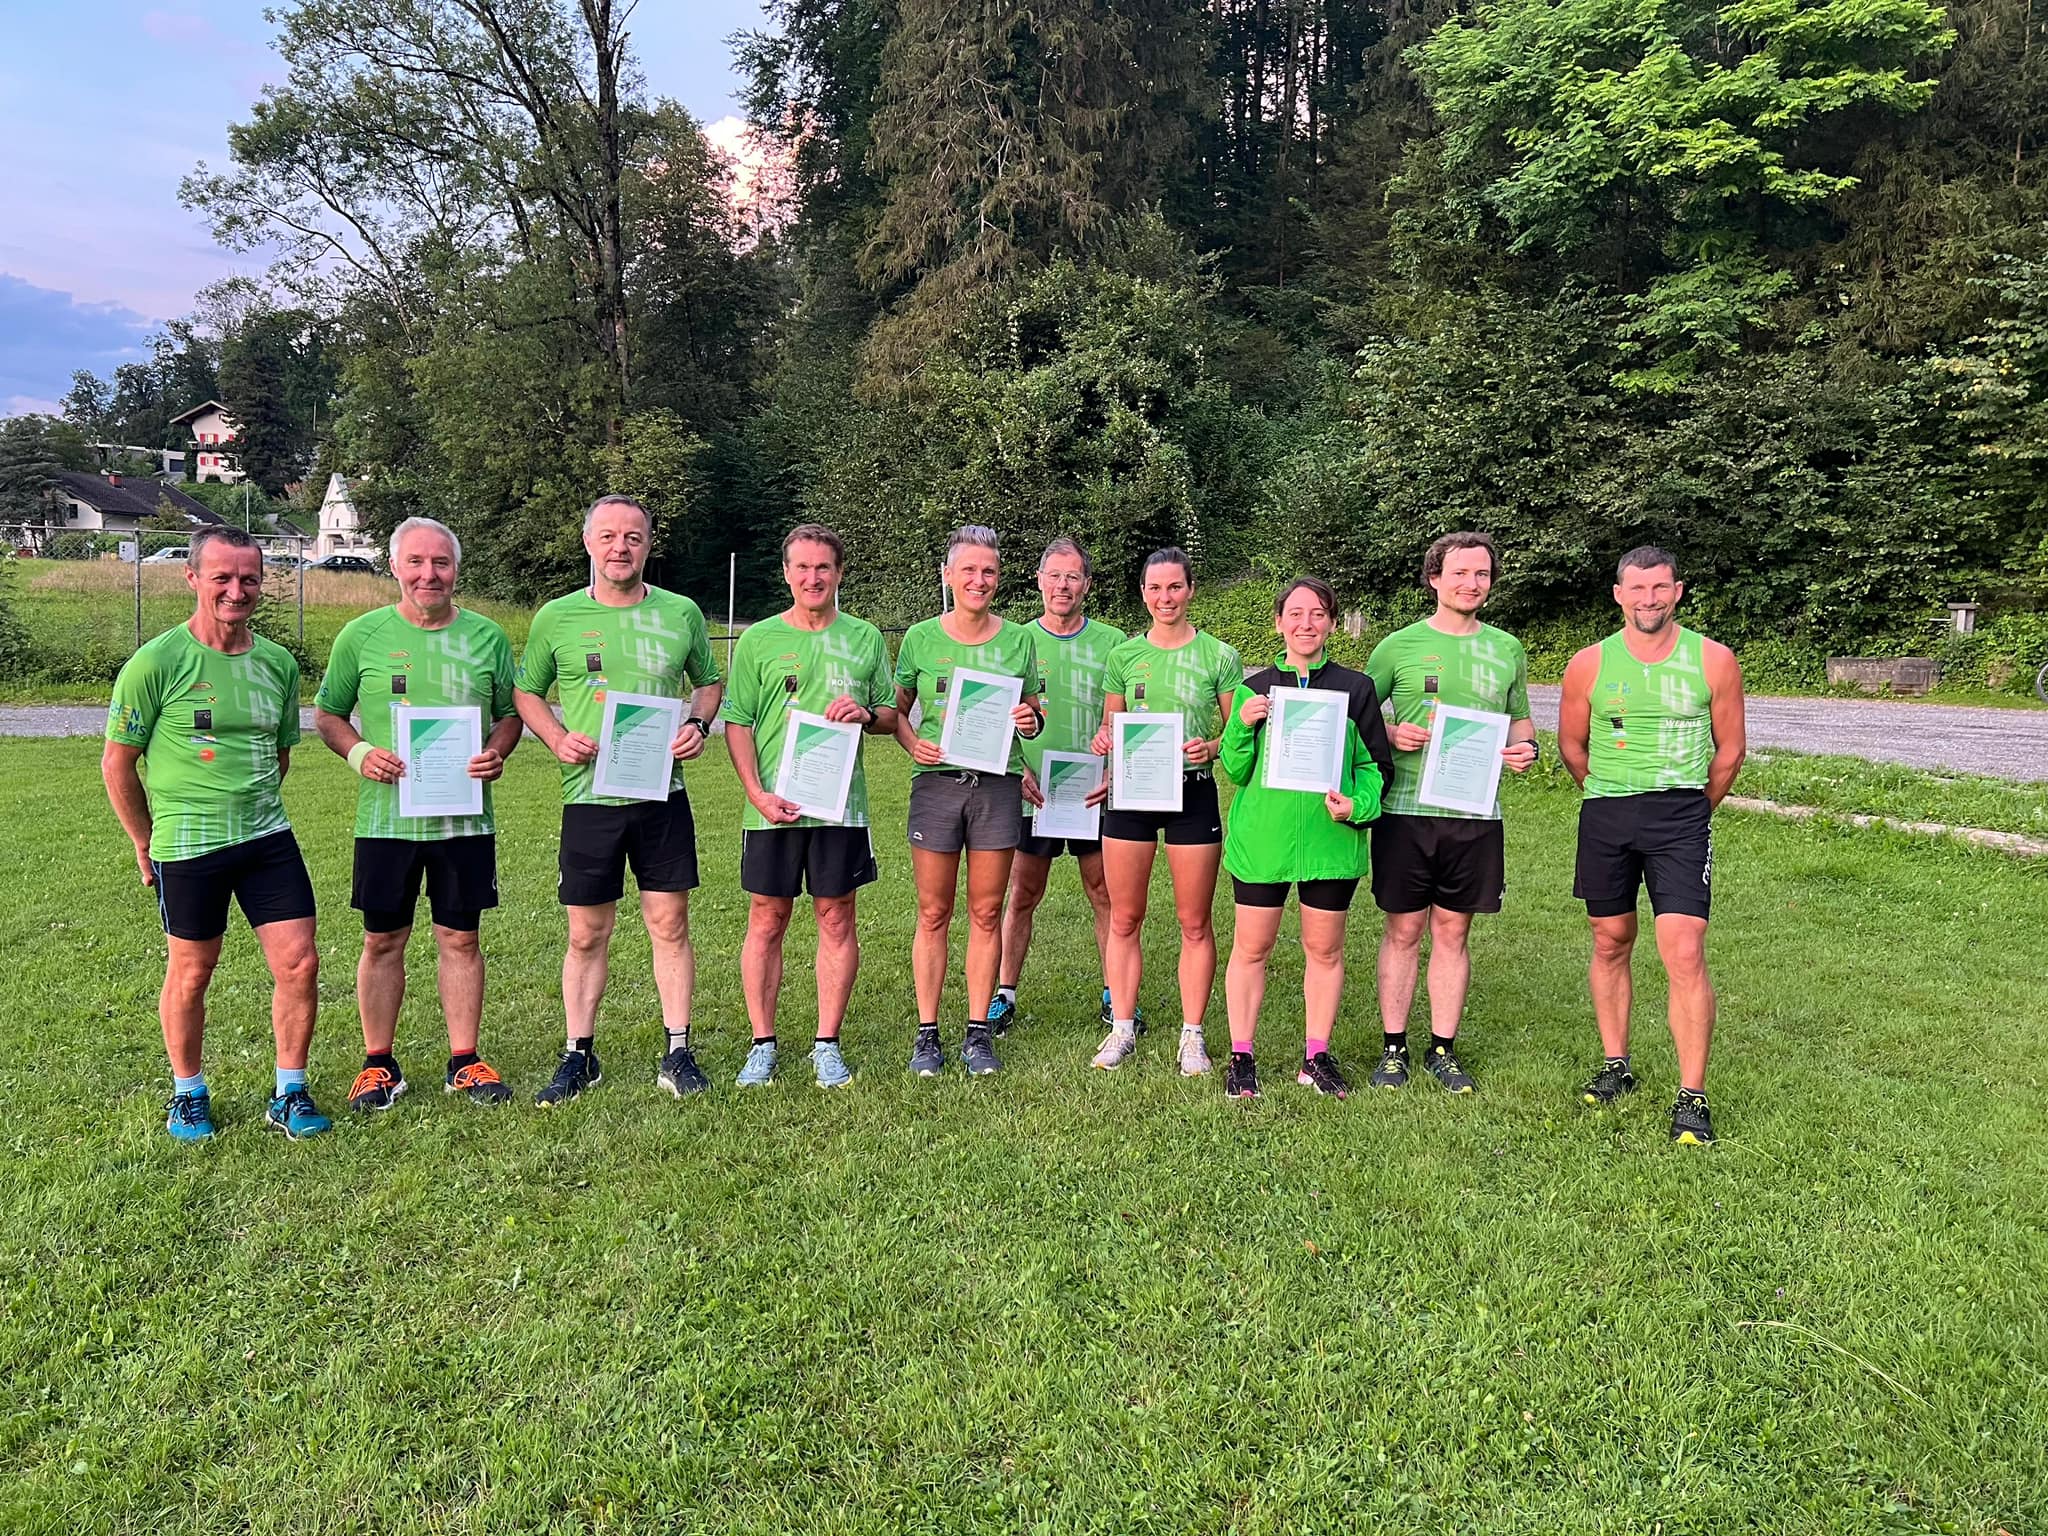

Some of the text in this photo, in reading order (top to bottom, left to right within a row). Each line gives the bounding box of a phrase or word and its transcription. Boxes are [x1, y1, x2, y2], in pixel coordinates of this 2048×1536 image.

[831, 679, 861, 688] ROLAND
[1665, 719, 1702, 728] WERNER
[415, 747, 423, 783] Zertifikat
